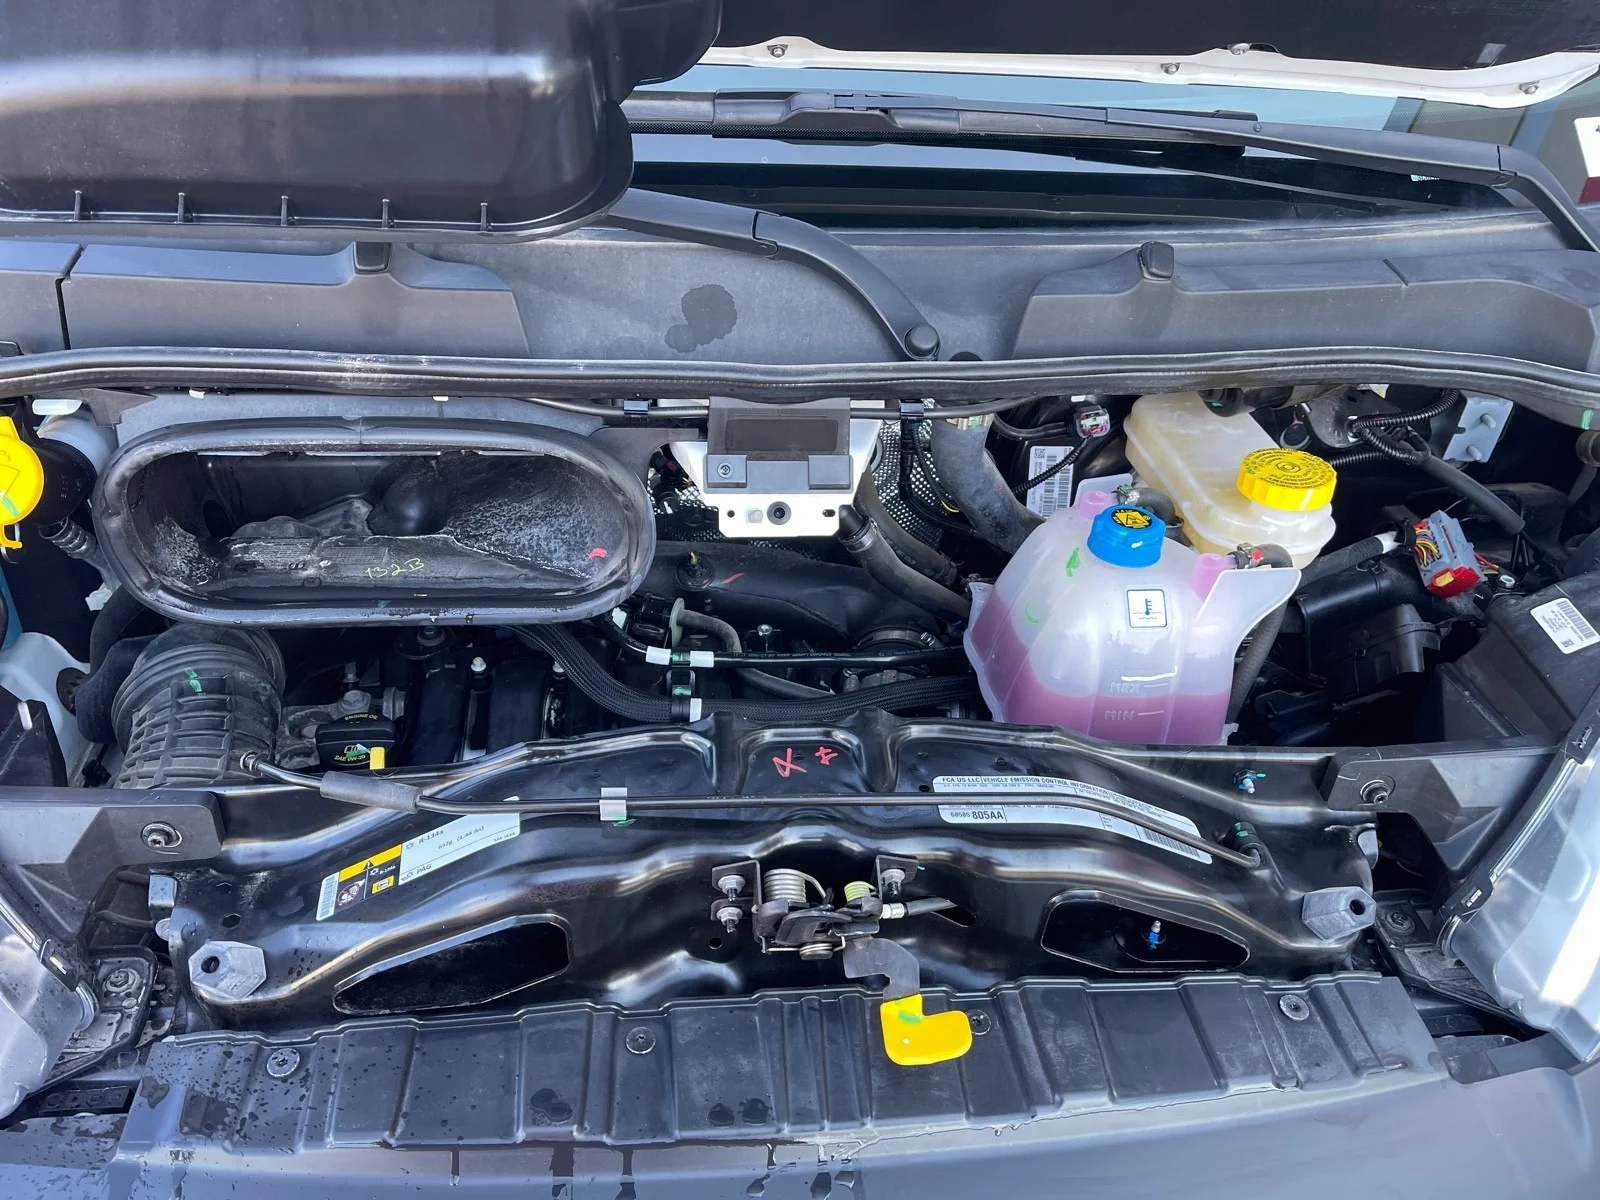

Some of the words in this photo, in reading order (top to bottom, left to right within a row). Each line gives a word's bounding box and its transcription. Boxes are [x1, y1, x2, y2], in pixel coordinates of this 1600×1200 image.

[344, 713, 368, 721] ENGINE
[1104, 710, 1135, 721] MIN
[334, 754, 346, 762] SAE
[1041, 777, 1069, 786] CONTROL
[1070, 780, 1108, 794] INFORMATION
[972, 810, 1004, 820] 805AA
[418, 830, 444, 844] R-134a
[416, 864, 432, 875] PAG
